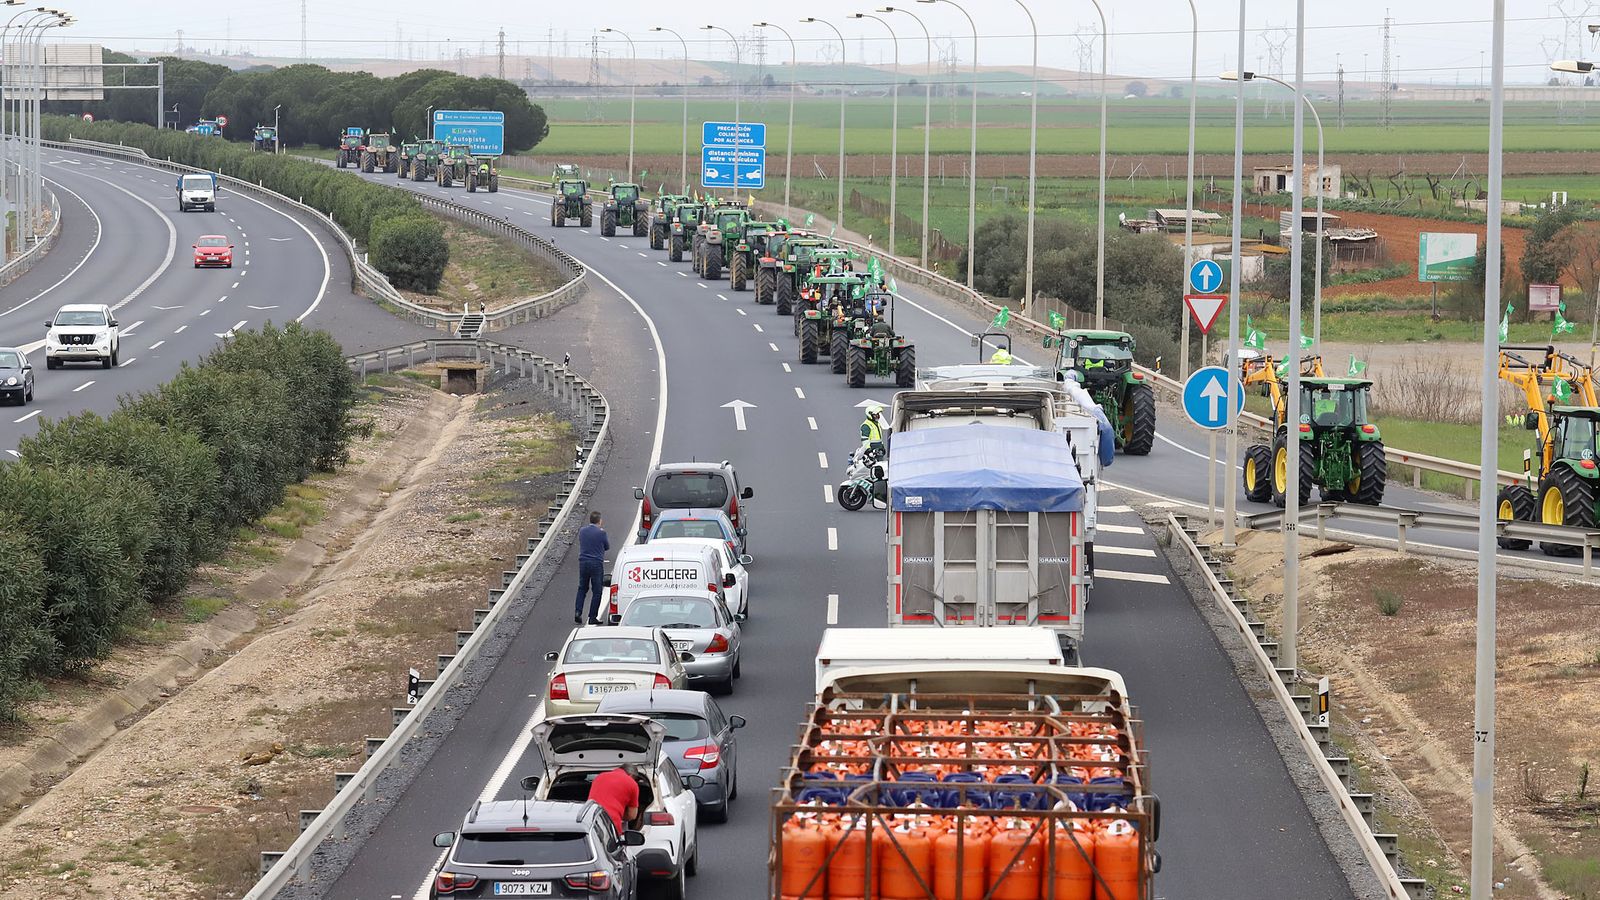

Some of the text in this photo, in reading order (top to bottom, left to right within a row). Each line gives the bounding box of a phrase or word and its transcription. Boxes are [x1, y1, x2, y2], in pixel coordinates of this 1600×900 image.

[453, 136, 486, 144] Autopista
[642, 568, 698, 580] KYOCERA
[594, 685, 613, 693] 3167
[1320, 715, 1326, 723] 2
[512, 868, 531, 877] Jeep
[502, 883, 548, 894] 9073 KZM
